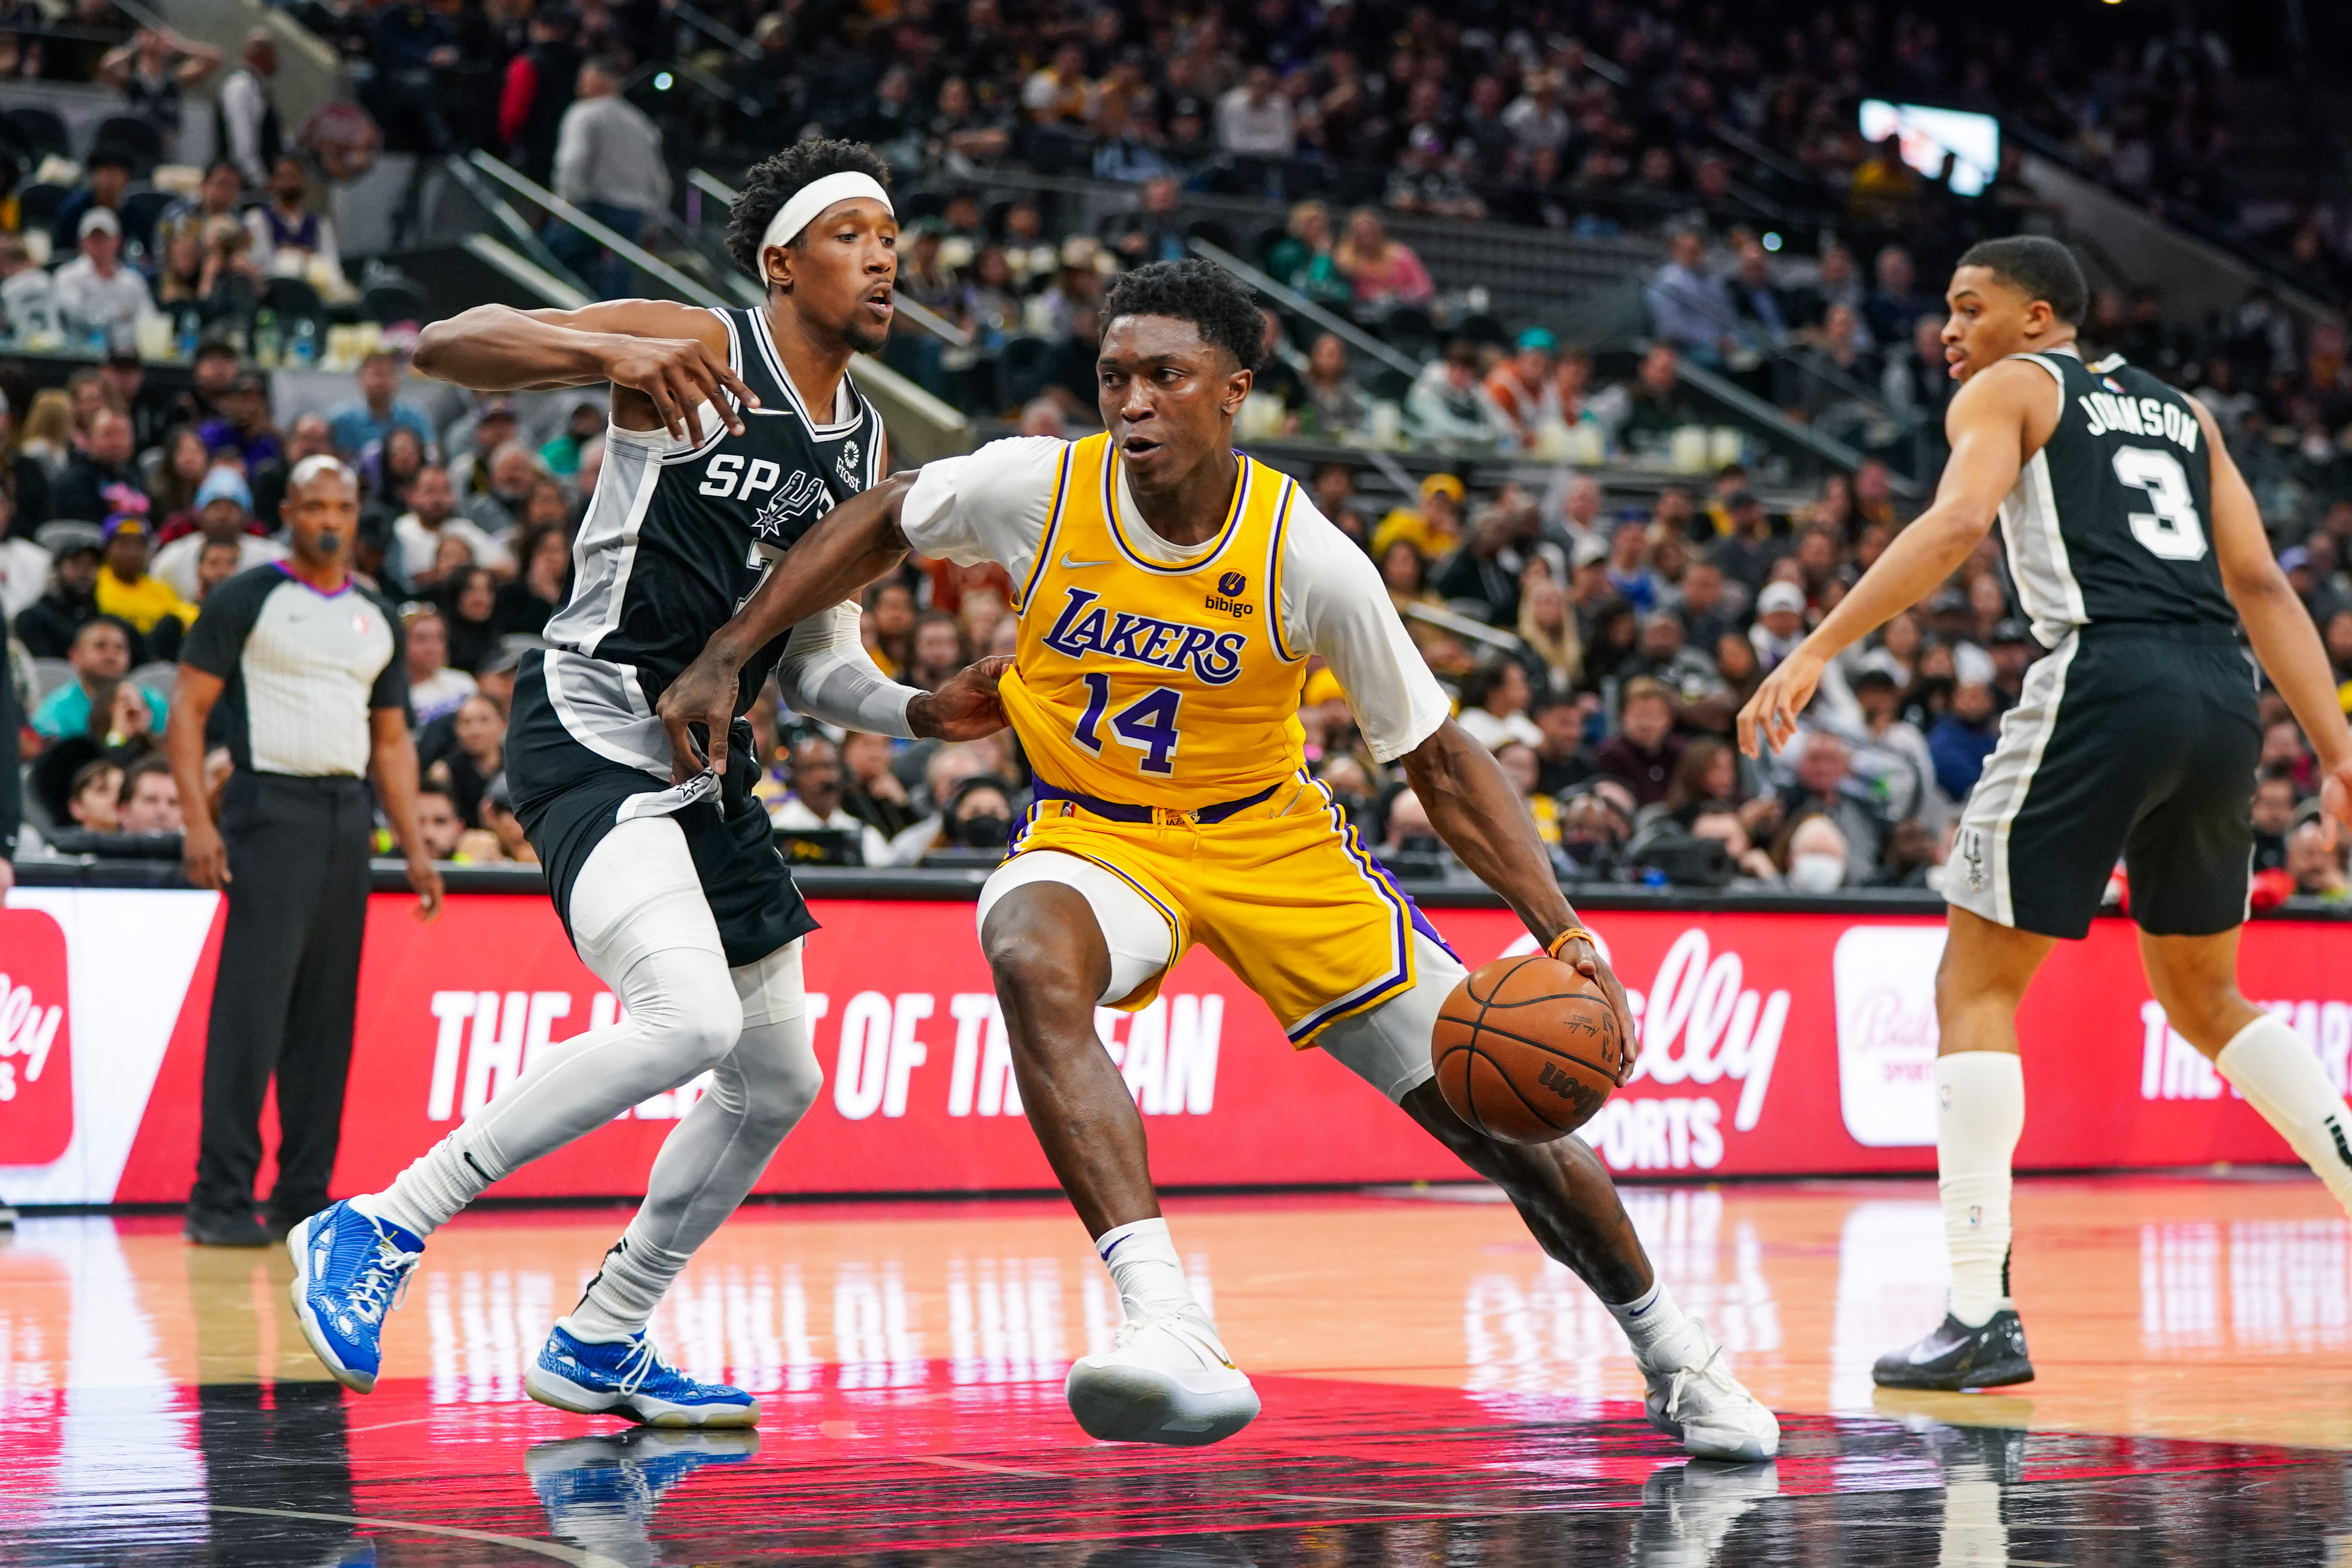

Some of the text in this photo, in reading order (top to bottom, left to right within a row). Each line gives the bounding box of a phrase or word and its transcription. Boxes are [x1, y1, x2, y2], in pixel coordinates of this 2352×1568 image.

[2078, 392, 2199, 453] JOHNSON
[835, 456, 862, 492] Frost
[2111, 444, 2208, 562] 3
[1042, 585, 1249, 686] LAKERS
[1205, 595, 1253, 618] bibigo
[1071, 672, 1184, 779] 14
[834, 991, 935, 1120] OF
[948, 993, 1026, 1117] TH
[1577, 1097, 1725, 1171] ORTS
